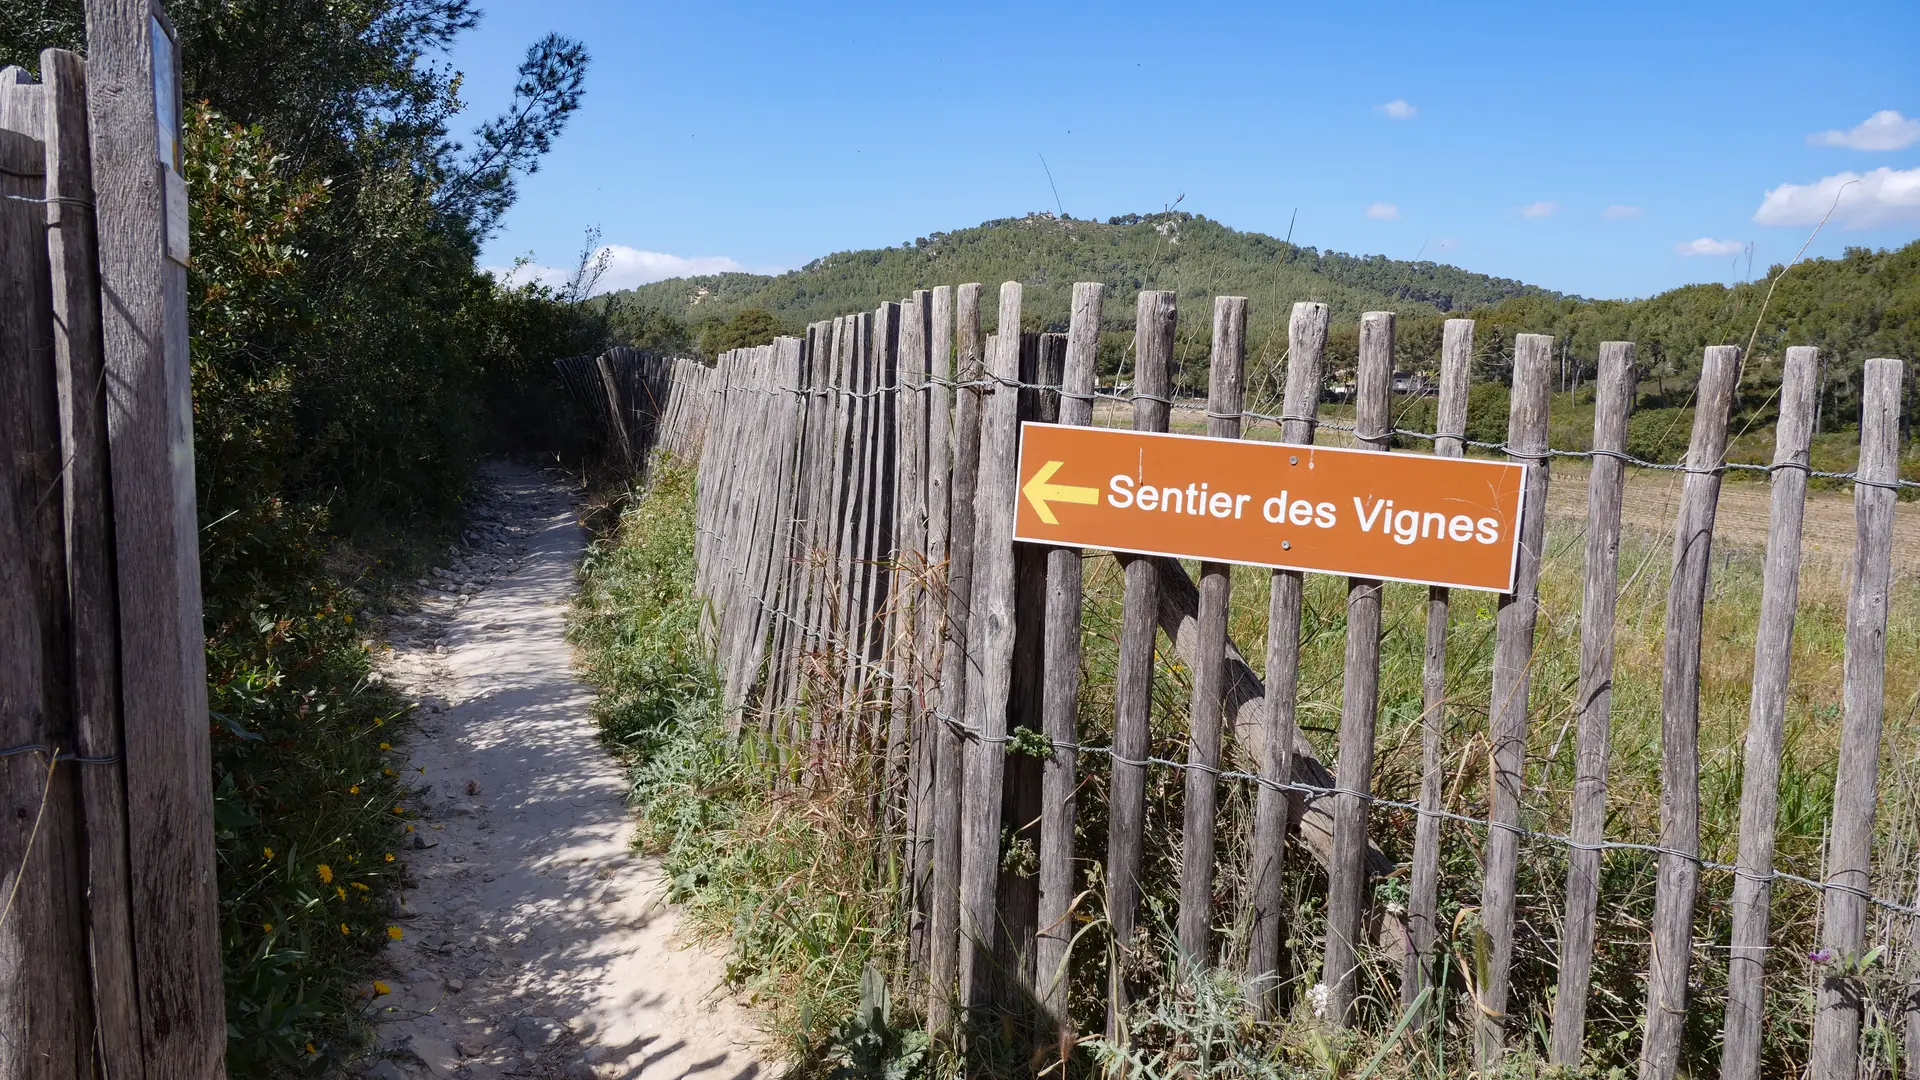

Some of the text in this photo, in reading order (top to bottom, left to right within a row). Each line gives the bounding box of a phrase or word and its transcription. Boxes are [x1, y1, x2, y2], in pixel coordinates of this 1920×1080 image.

[1107, 474, 1499, 546] Sentier des Vignes
